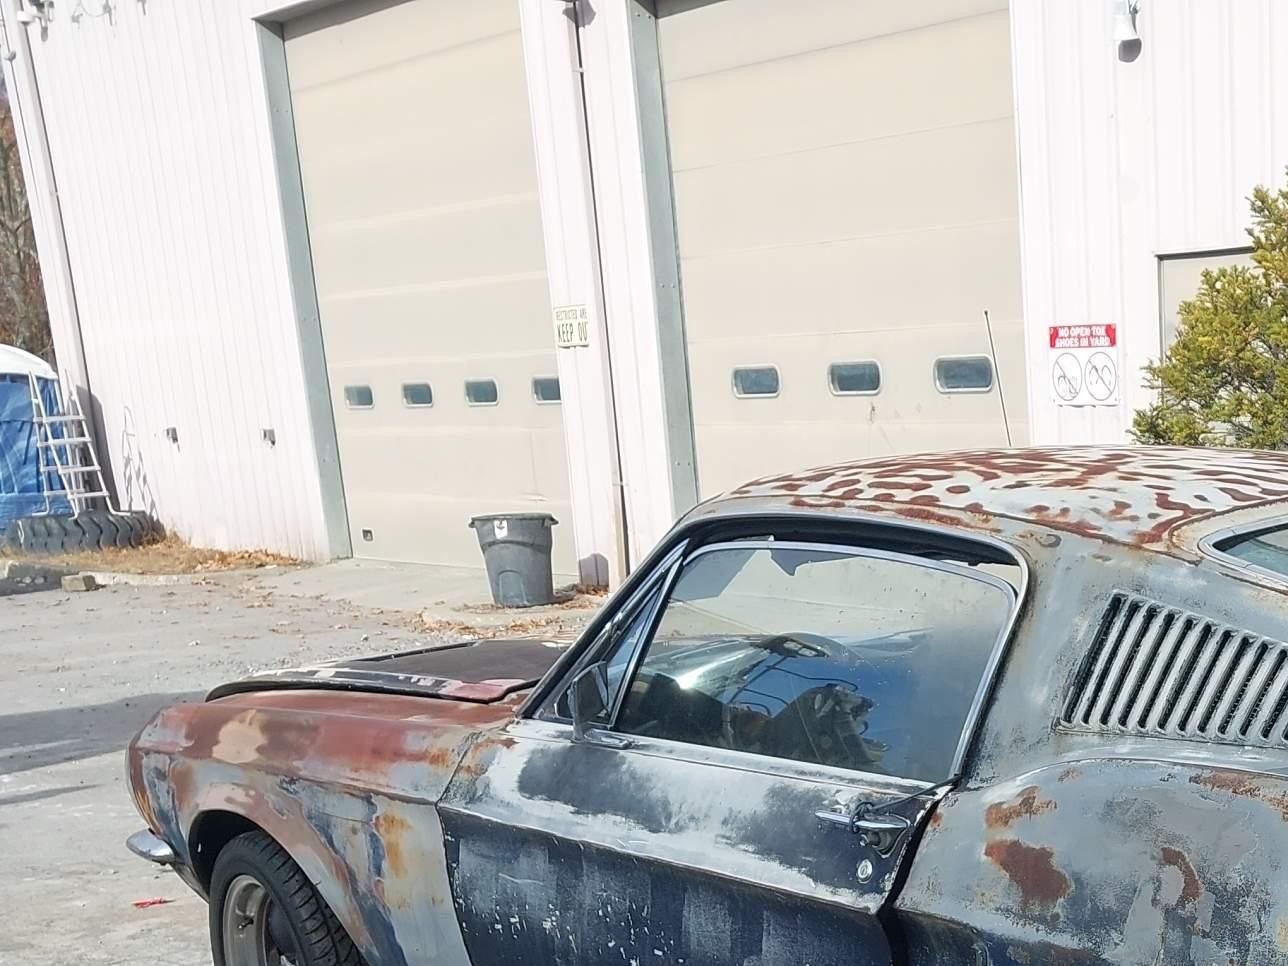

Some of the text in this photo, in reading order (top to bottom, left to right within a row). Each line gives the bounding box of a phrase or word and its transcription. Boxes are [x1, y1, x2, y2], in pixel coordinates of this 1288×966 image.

[557, 322, 574, 343] KEEP
[1058, 325, 1106, 337] NO OPEN TOE
[1055, 335, 1110, 348] SHOES IN YARD
